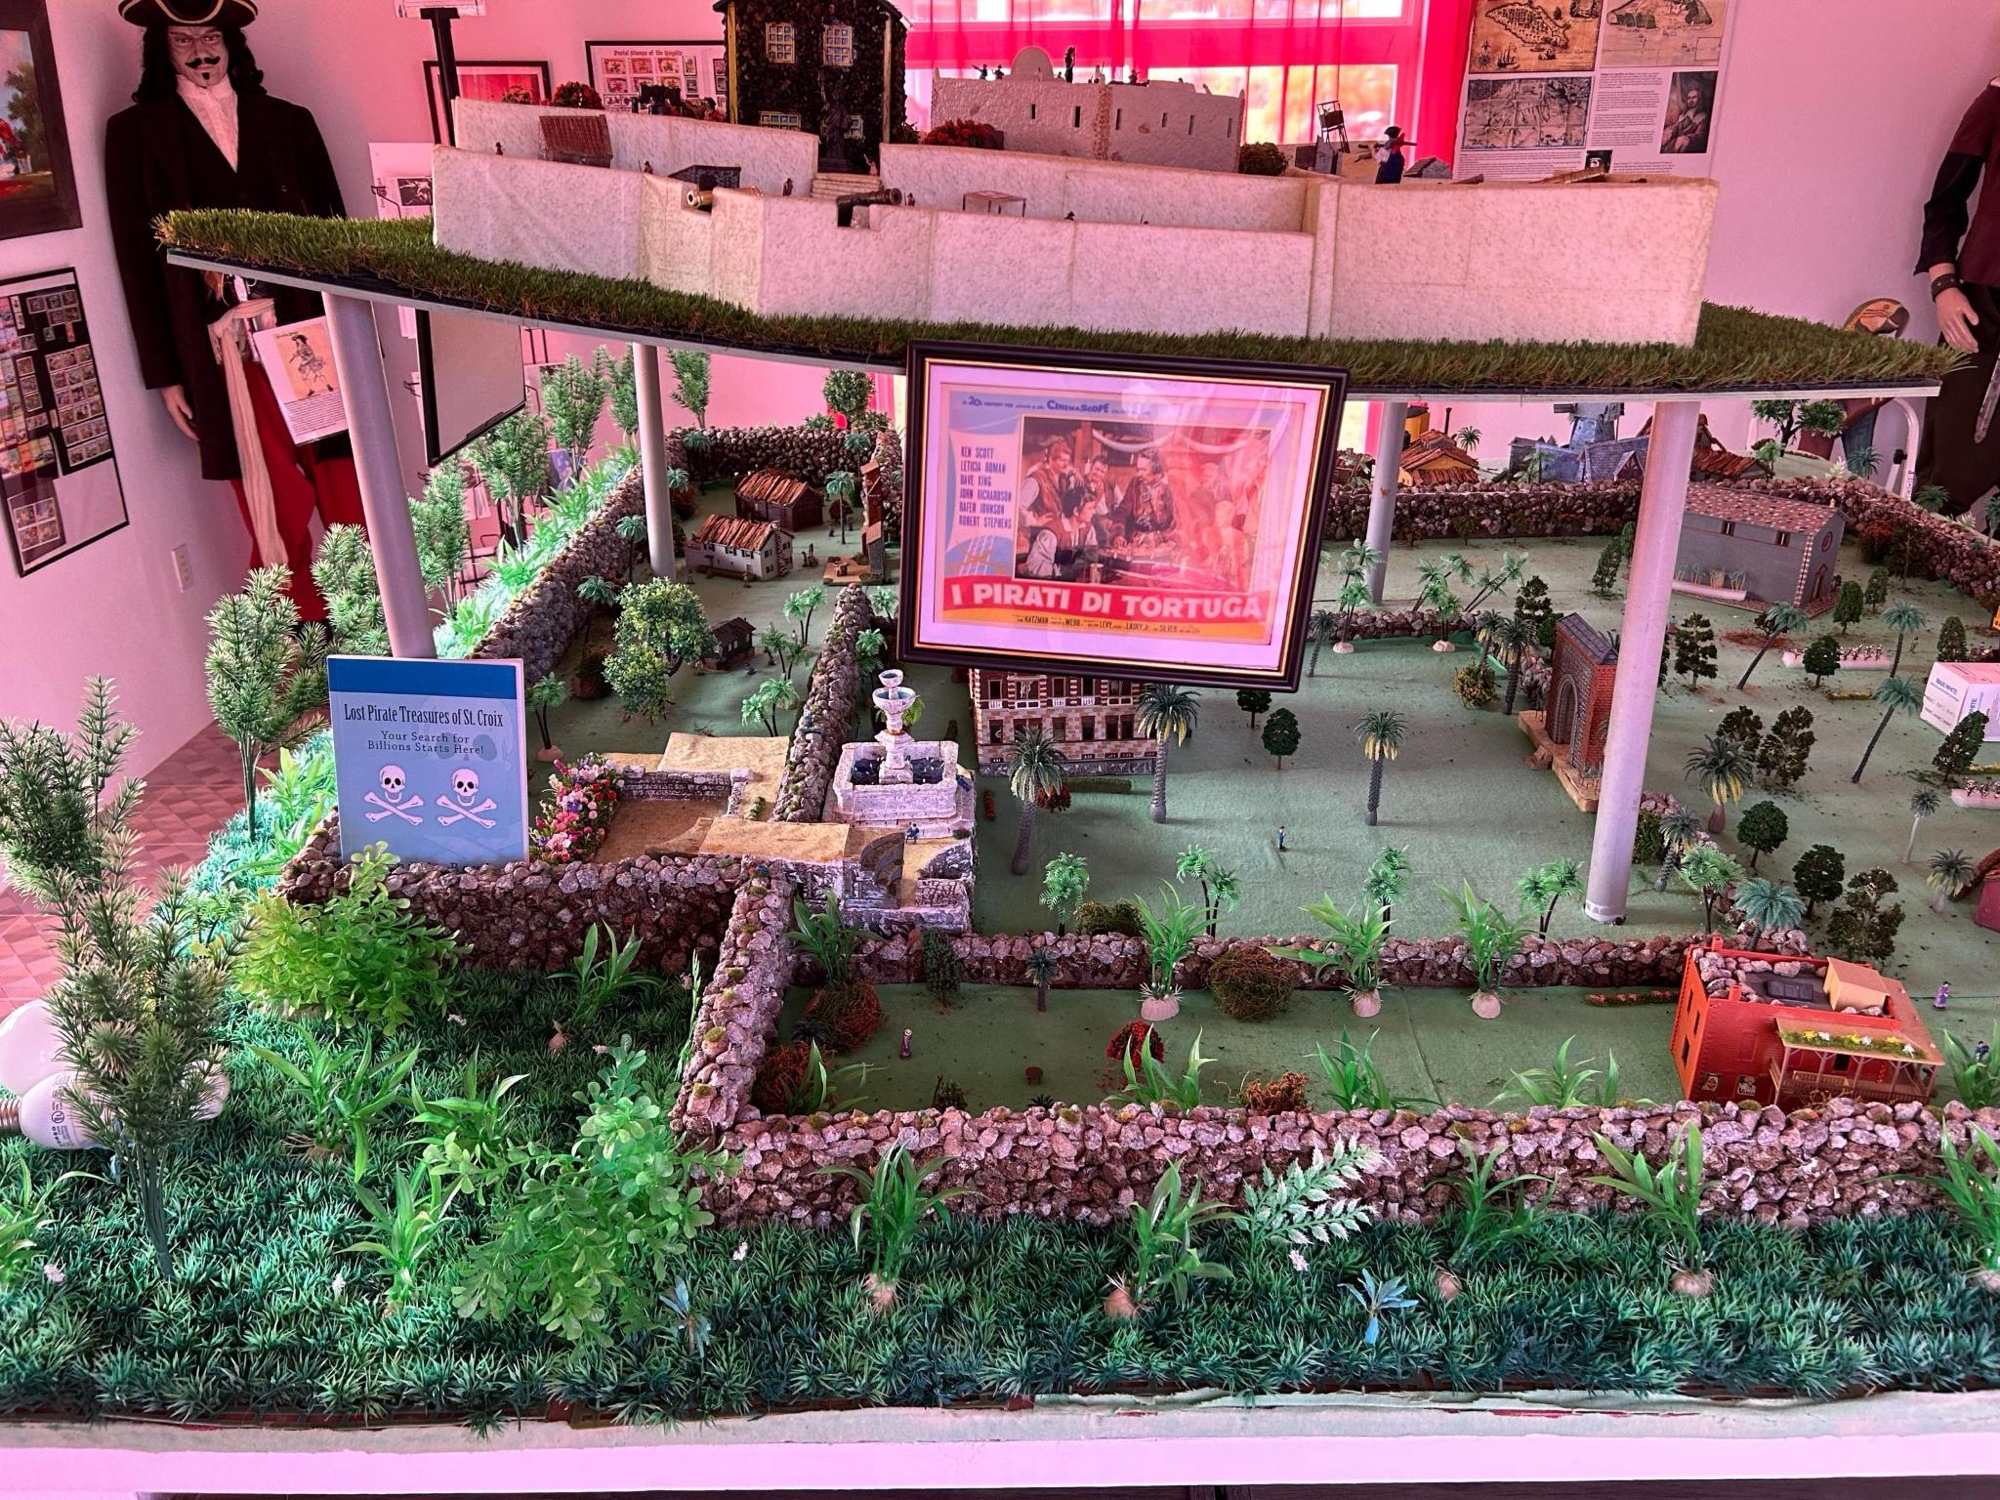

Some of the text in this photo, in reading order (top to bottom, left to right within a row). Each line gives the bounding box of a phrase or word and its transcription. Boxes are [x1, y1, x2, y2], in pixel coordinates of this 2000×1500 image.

[961, 446, 994, 459] KEN SCOTT
[960, 460, 981, 472] LETICIA
[960, 474, 992, 487] DAVE KING
[960, 488, 1011, 502] JOHN RICHARDSON
[960, 502, 1004, 514] RAFER JOHNSON
[959, 516, 1011, 529] ROBERT STEPHENS
[951, 583, 1264, 620] I PIRATI DI TORTUGA
[344, 704, 503, 727] Lost Pirate Treasures of St. Croix
[381, 730, 470, 743] Your Search for
[368, 740, 484, 754] Billions Starts Here!
